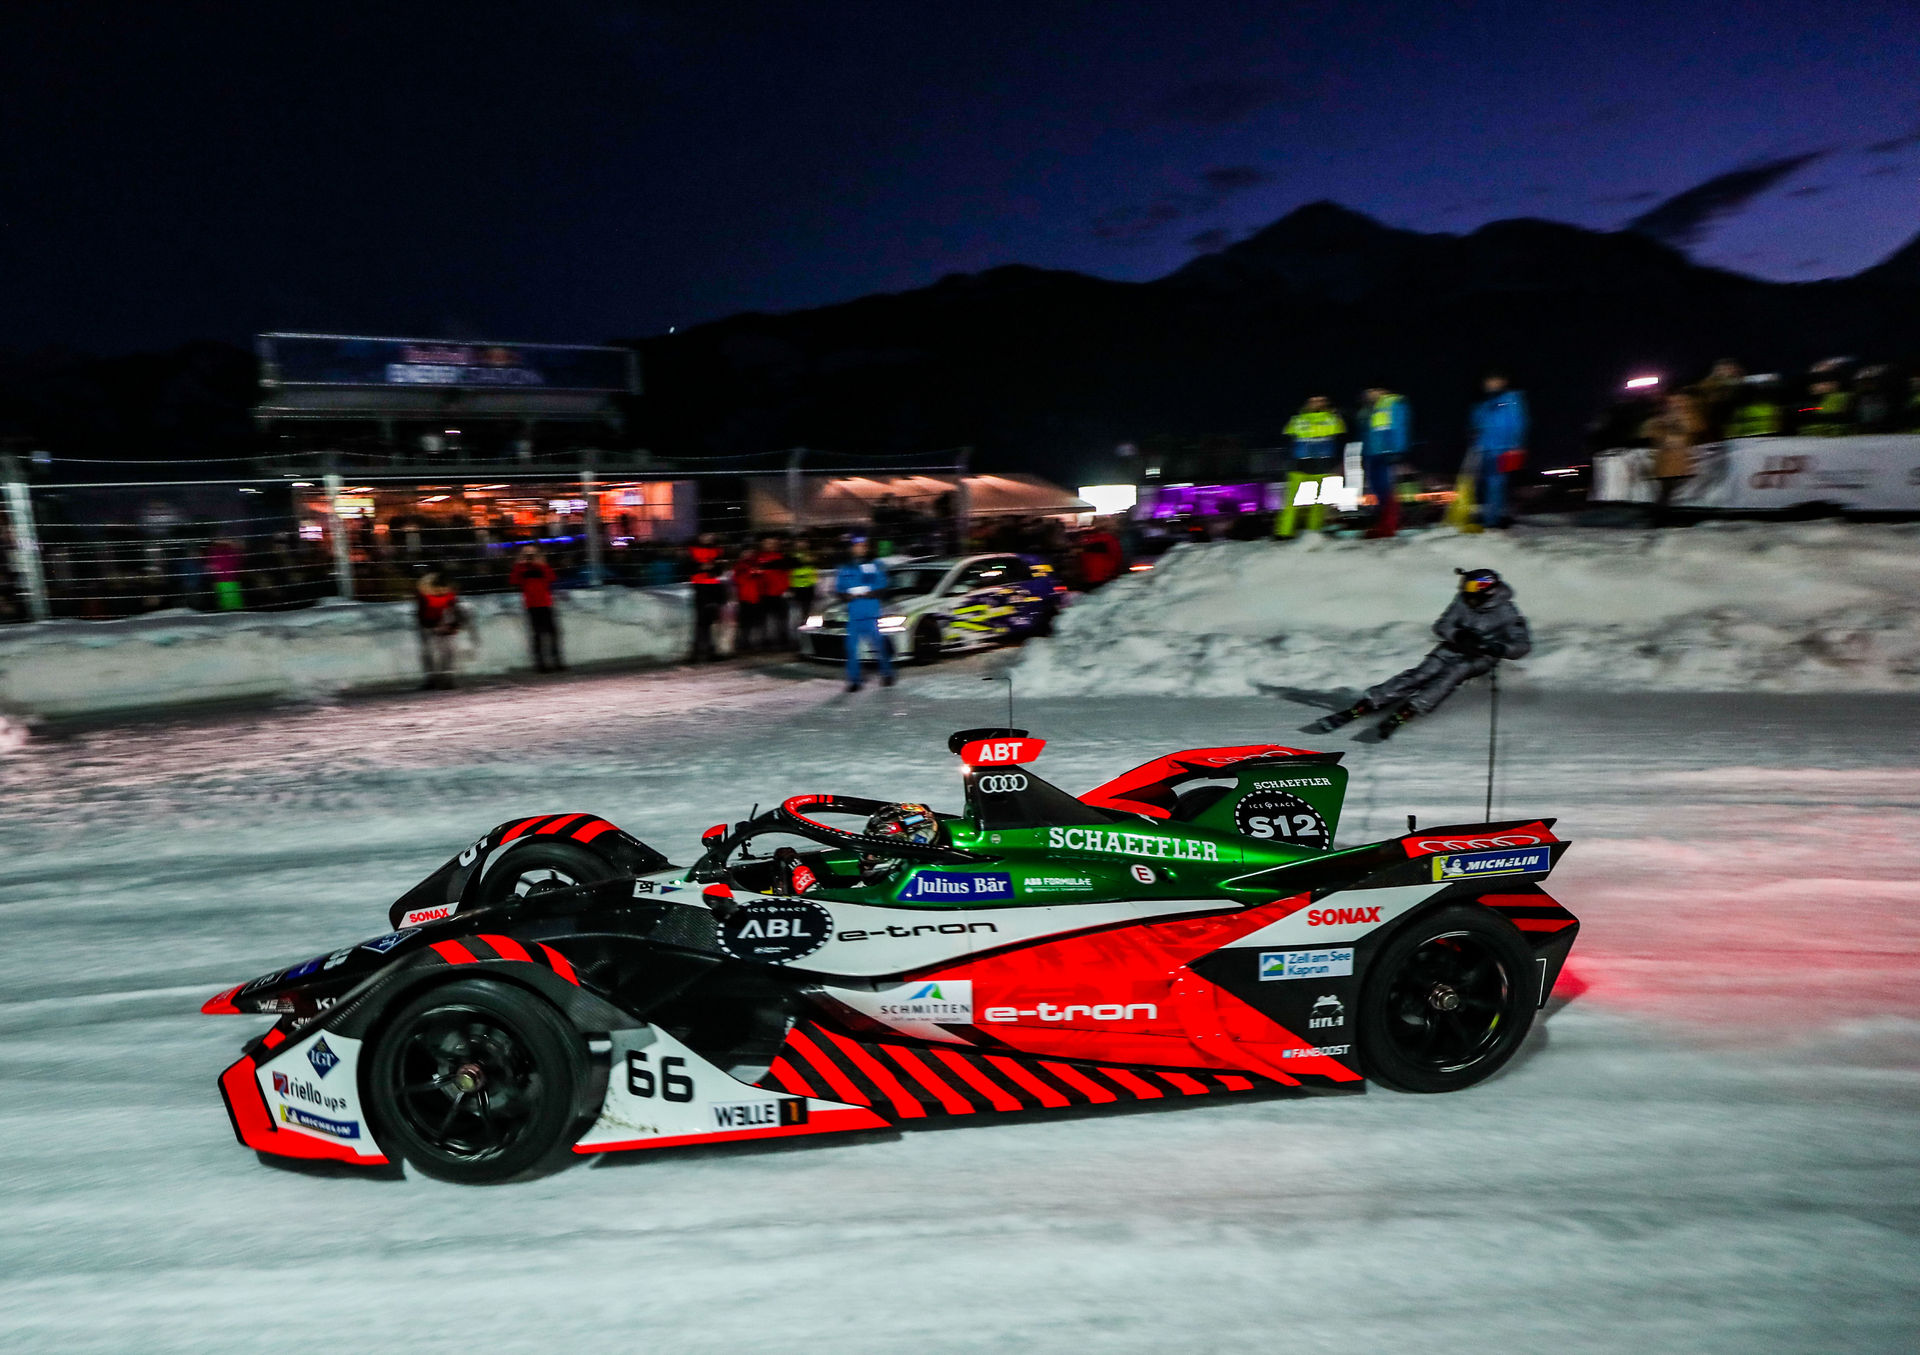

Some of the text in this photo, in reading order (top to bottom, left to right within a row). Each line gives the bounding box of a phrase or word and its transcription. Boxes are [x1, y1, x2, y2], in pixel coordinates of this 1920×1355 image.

[978, 742, 1023, 762] ABT
[1253, 777, 1332, 790] SCHAEFFLER
[1248, 814, 1320, 839] S12
[1048, 827, 1219, 862] SCHAEFFLER
[1466, 855, 1540, 871] MICHELIN
[1137, 867, 1152, 882] E
[916, 876, 1007, 896] Julius Bär
[409, 907, 450, 923] SONAX
[1307, 906, 1381, 926] SONAX
[737, 918, 812, 940] ABL
[837, 922, 998, 942] e-tron
[1288, 951, 1351, 964] Zell am See
[1288, 965, 1329, 977] Kaprun
[880, 1003, 971, 1015] SCHMITTEN
[984, 1002, 1158, 1022] e-tron
[626, 1049, 694, 1103] 66
[290, 1077, 347, 1112] riello ups
[788, 1101, 799, 1122] 1
